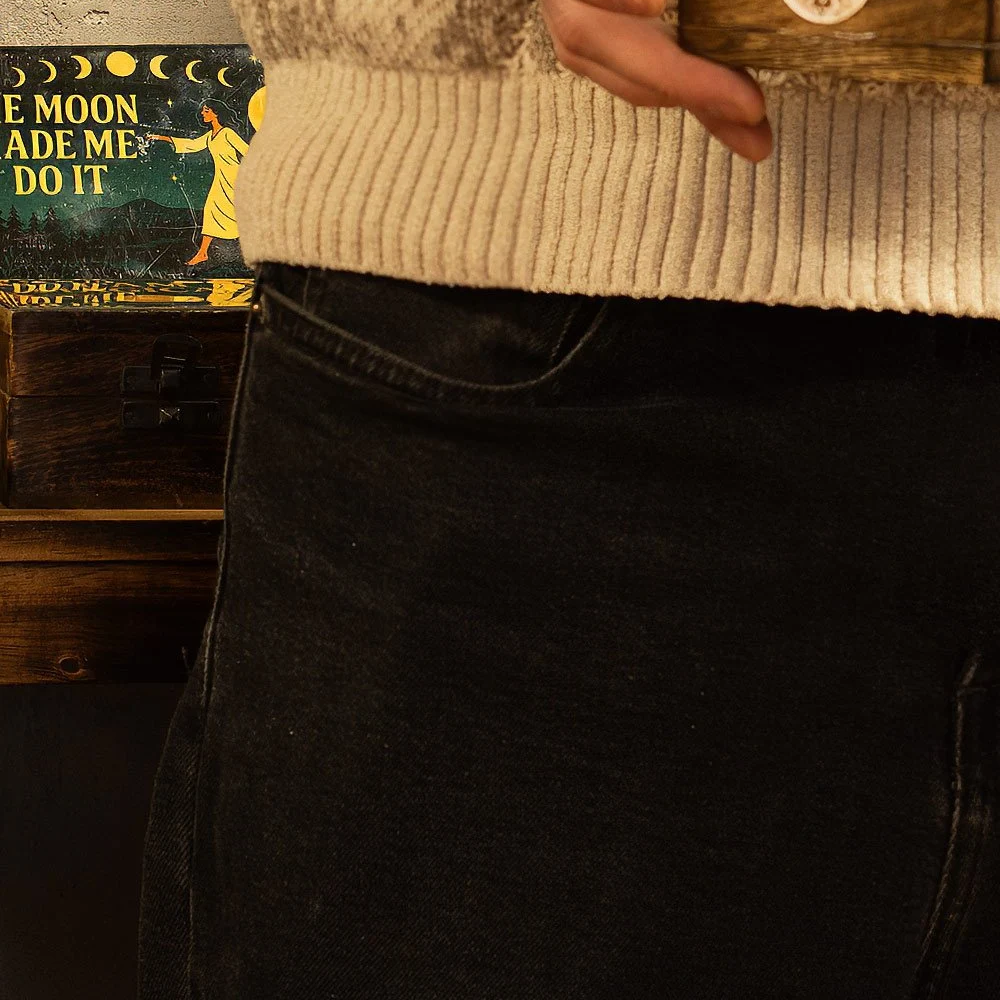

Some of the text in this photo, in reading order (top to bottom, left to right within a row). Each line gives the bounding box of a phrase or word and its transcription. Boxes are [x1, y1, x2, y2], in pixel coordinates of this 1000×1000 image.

[33, 94, 139, 124] MOON
[0, 129, 138, 160] ADE ME
[12, 164, 108, 196] DO IT
